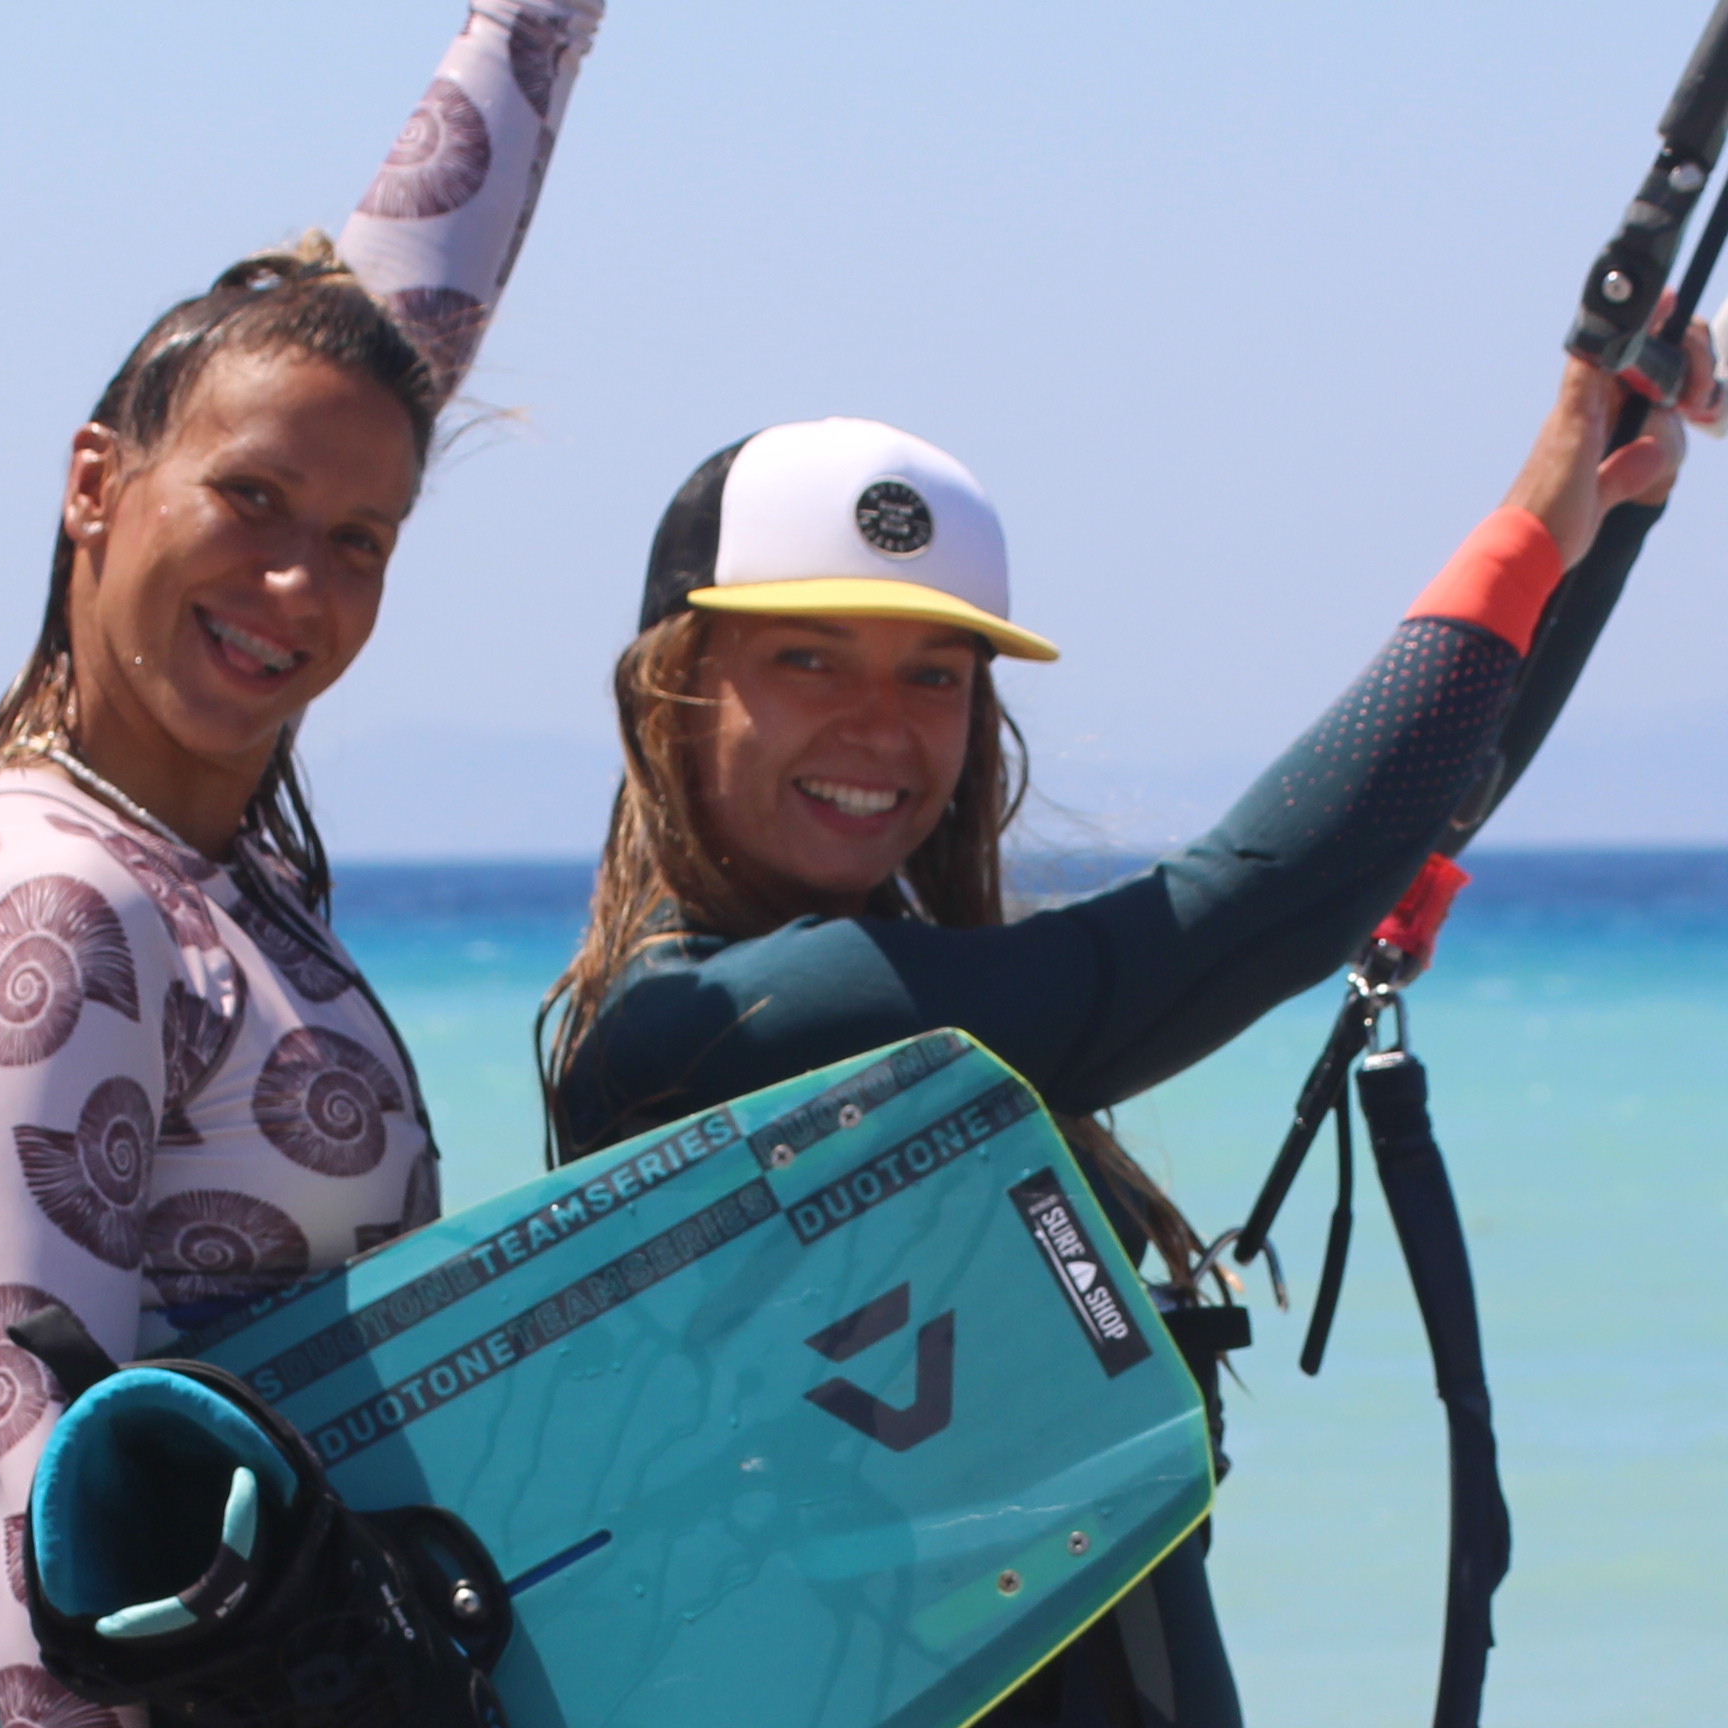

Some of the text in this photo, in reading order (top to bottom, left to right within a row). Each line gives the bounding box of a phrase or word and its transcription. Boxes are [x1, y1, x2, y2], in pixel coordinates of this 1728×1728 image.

[470, 1112, 732, 1275] TEAMSERIES
[794, 1103, 991, 1237] DUOTONE
[1041, 1206, 1086, 1259] SURF
[1085, 1285, 1129, 1340] SHOP
[319, 1329, 518, 1460] DUOTONE
